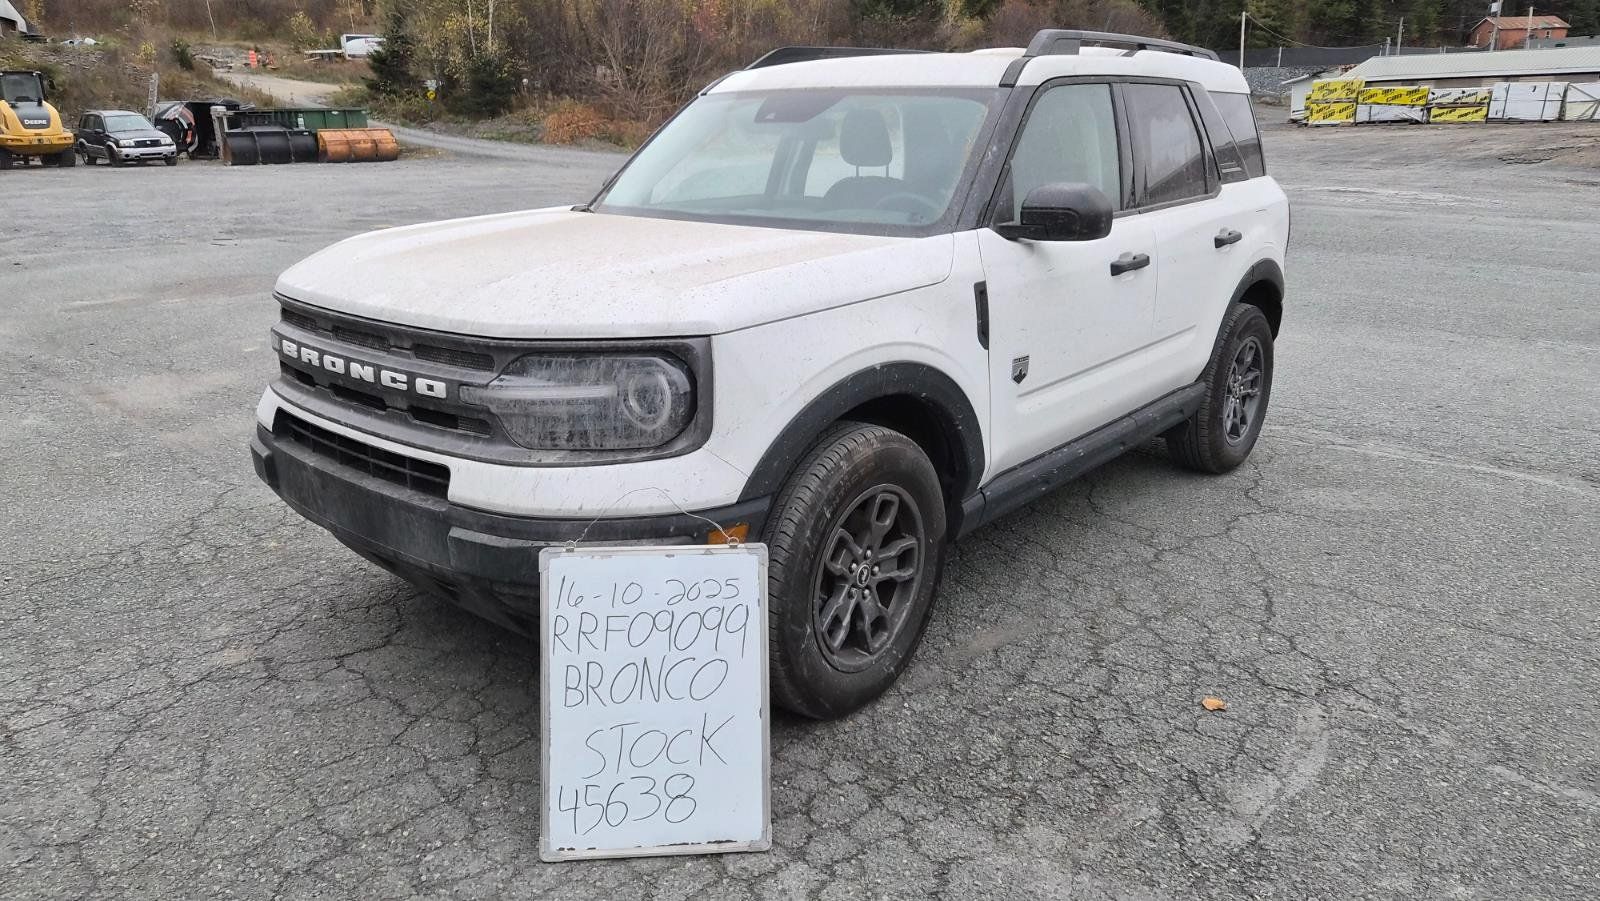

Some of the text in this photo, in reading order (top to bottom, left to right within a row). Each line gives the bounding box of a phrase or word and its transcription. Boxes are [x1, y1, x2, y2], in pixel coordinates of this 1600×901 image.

[282, 339, 447, 399] BRONCO
[552, 602, 749, 658] RRF09099
[564, 655, 729, 708] BRONCO
[582, 712, 735, 780] STOCK
[558, 773, 697, 835] 45638
